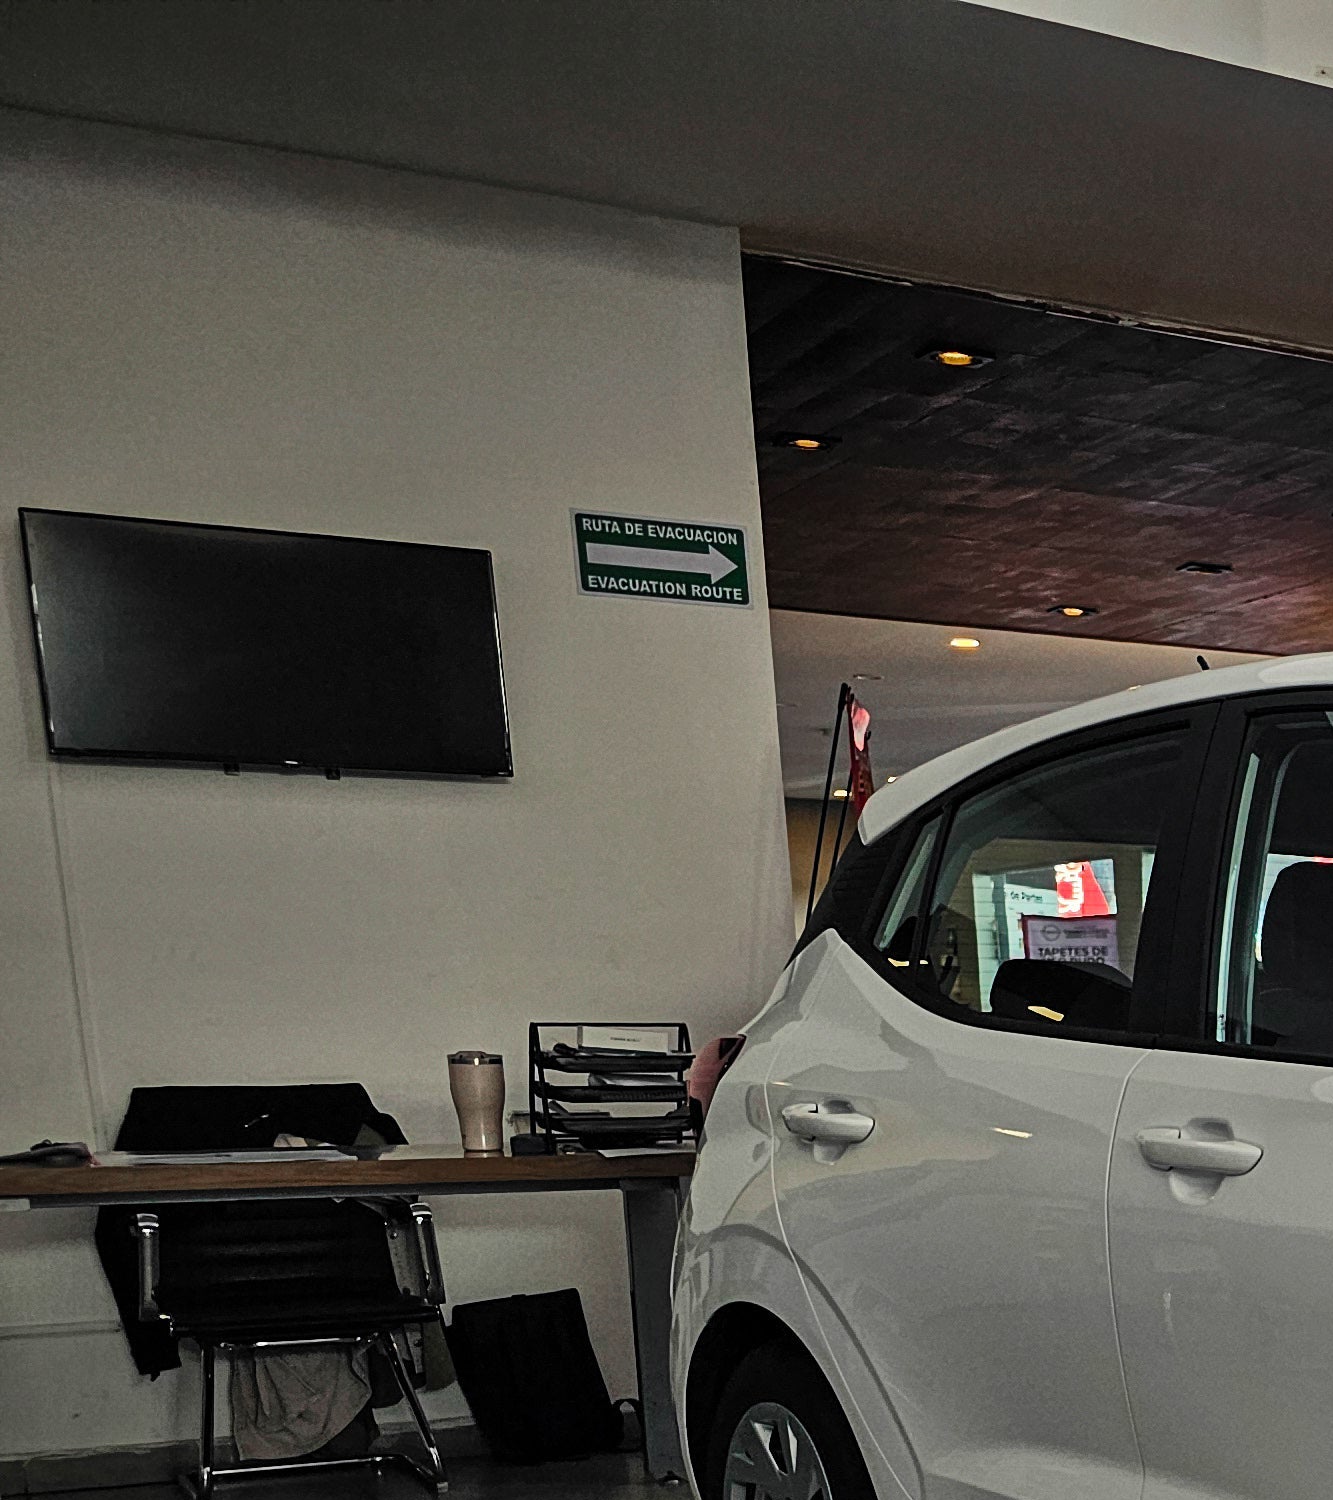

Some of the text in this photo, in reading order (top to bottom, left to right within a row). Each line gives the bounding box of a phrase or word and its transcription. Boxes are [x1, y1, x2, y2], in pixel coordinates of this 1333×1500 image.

[582, 518, 738, 545] RUTA DE EVACUACION
[587, 575, 743, 601] EVACUATION ROUTE
[1038, 946, 1108, 956] TAPETES DE
